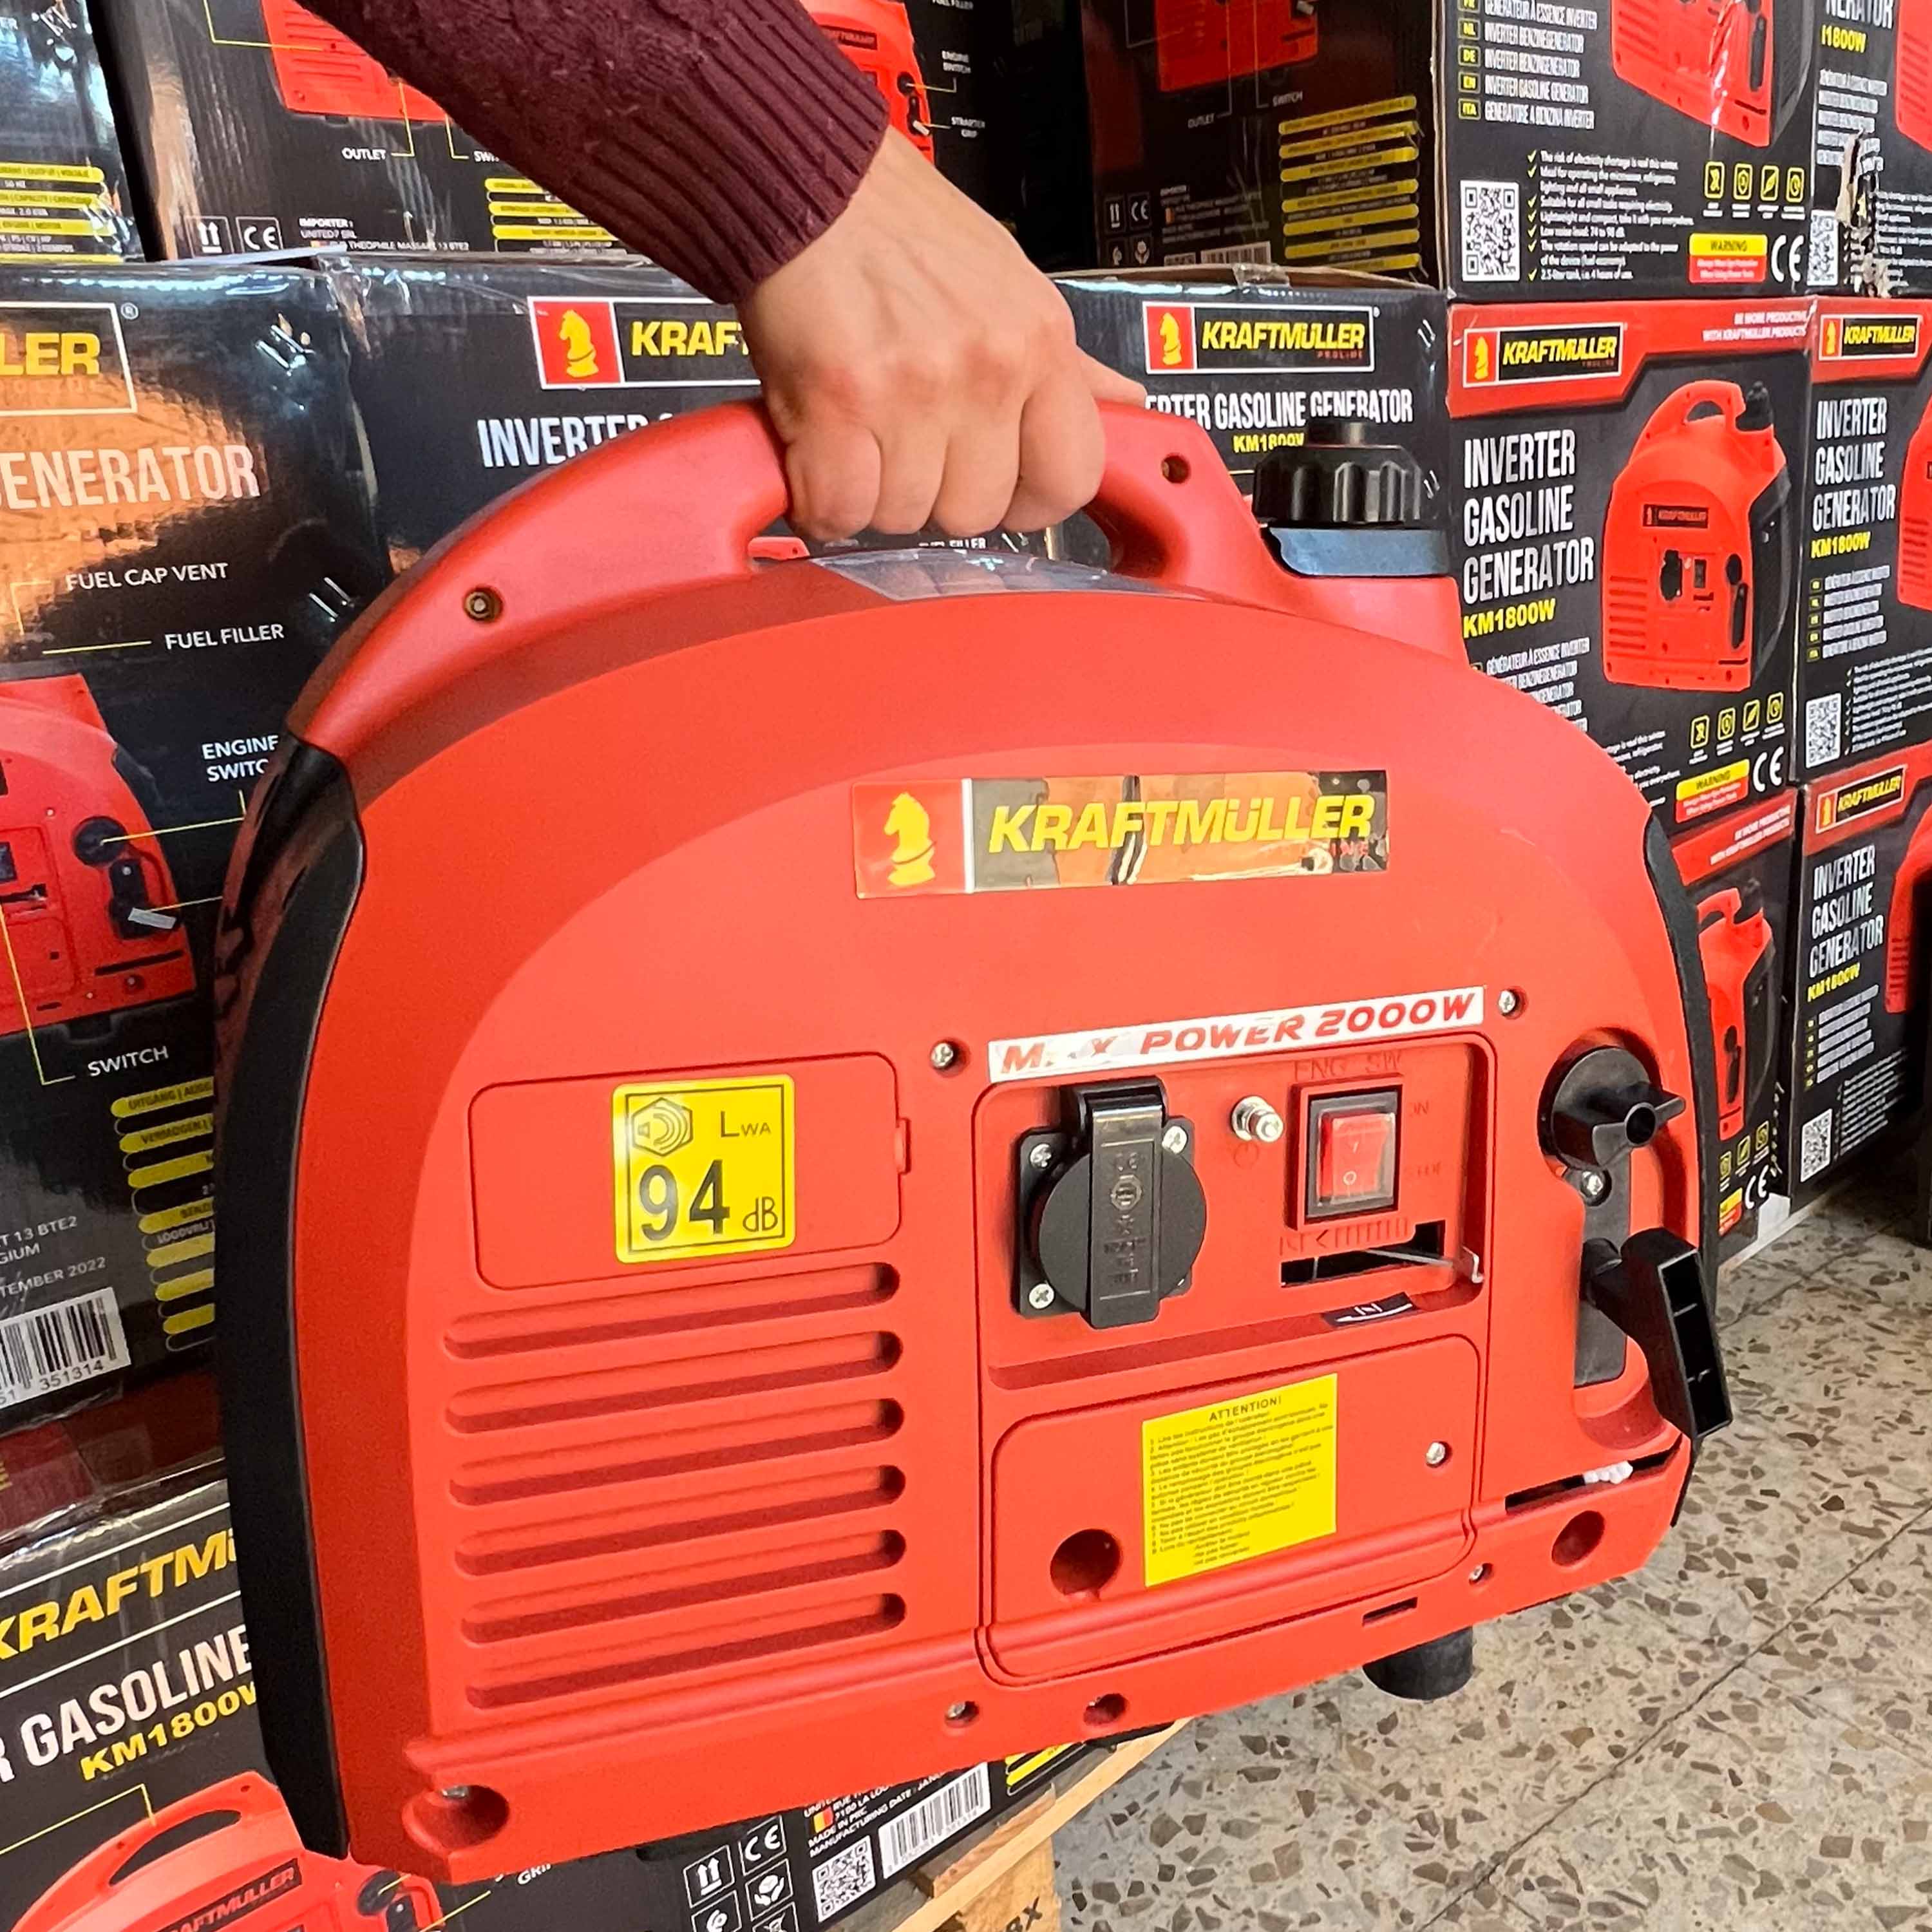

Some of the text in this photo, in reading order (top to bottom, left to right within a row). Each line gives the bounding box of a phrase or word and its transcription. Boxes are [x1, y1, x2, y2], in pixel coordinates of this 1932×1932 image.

[342, 147, 386, 160] OUTLET
[474, 150, 500, 162] SWI
[1710, 240, 1748, 252] WARNING
[0, 332, 100, 375] LER
[1202, 321, 1366, 350] KRAFTMÜLLER
[1215, 392, 1307, 431] GASOLINE
[1310, 389, 1413, 424] GENERATOR
[1817, 397, 1888, 440] INVERTER
[0, 443, 261, 511] ENERATOR
[1464, 429, 1576, 489] INVERTER
[1815, 441, 1886, 486] GASOLINE
[1463, 485, 1575, 547] GASOLINE
[1812, 484, 1897, 532] GENERATOR
[1811, 531, 1871, 559] KM1800W
[65, 562, 229, 592] FUEL CAP VENT
[1463, 536, 1596, 605] GENERATOR
[165, 623, 285, 650] FUEL FILLER
[1463, 598, 1557, 639] KM1800W
[1696, 770, 1732, 790] WARNING
[988, 793, 1375, 855] KRAFTMÜLLER
[1814, 844, 1876, 901] INVERTER
[1812, 882, 1873, 940] GASOLINE
[1810, 914, 1884, 979] GENERATOR
[1807, 962, 1861, 1003] KM1800W
[1000, 992, 1475, 1074] MX POWER 2000W
[88, 1045, 169, 1077] SWITCH
[1294, 1056, 1347, 1081] ENG
[639, 1159, 730, 1242] 94
[742, 1196, 779, 1233] dB
[14, 1215, 78, 1243] 13 BTE2
[68, 1256, 106, 1278] 2022
[39, 1359, 104, 1392] 351314
[1209, 1396, 1282, 1422] ATTENTION!
[20, 1624, 253, 1767] GASOLINE
[745, 1824, 781, 1862] CE
[808, 1806, 869, 1848] MADE IN PRC
[810, 1803, 889, 1858] MANUFACTURING
[889, 1789, 913, 1809] DATE
